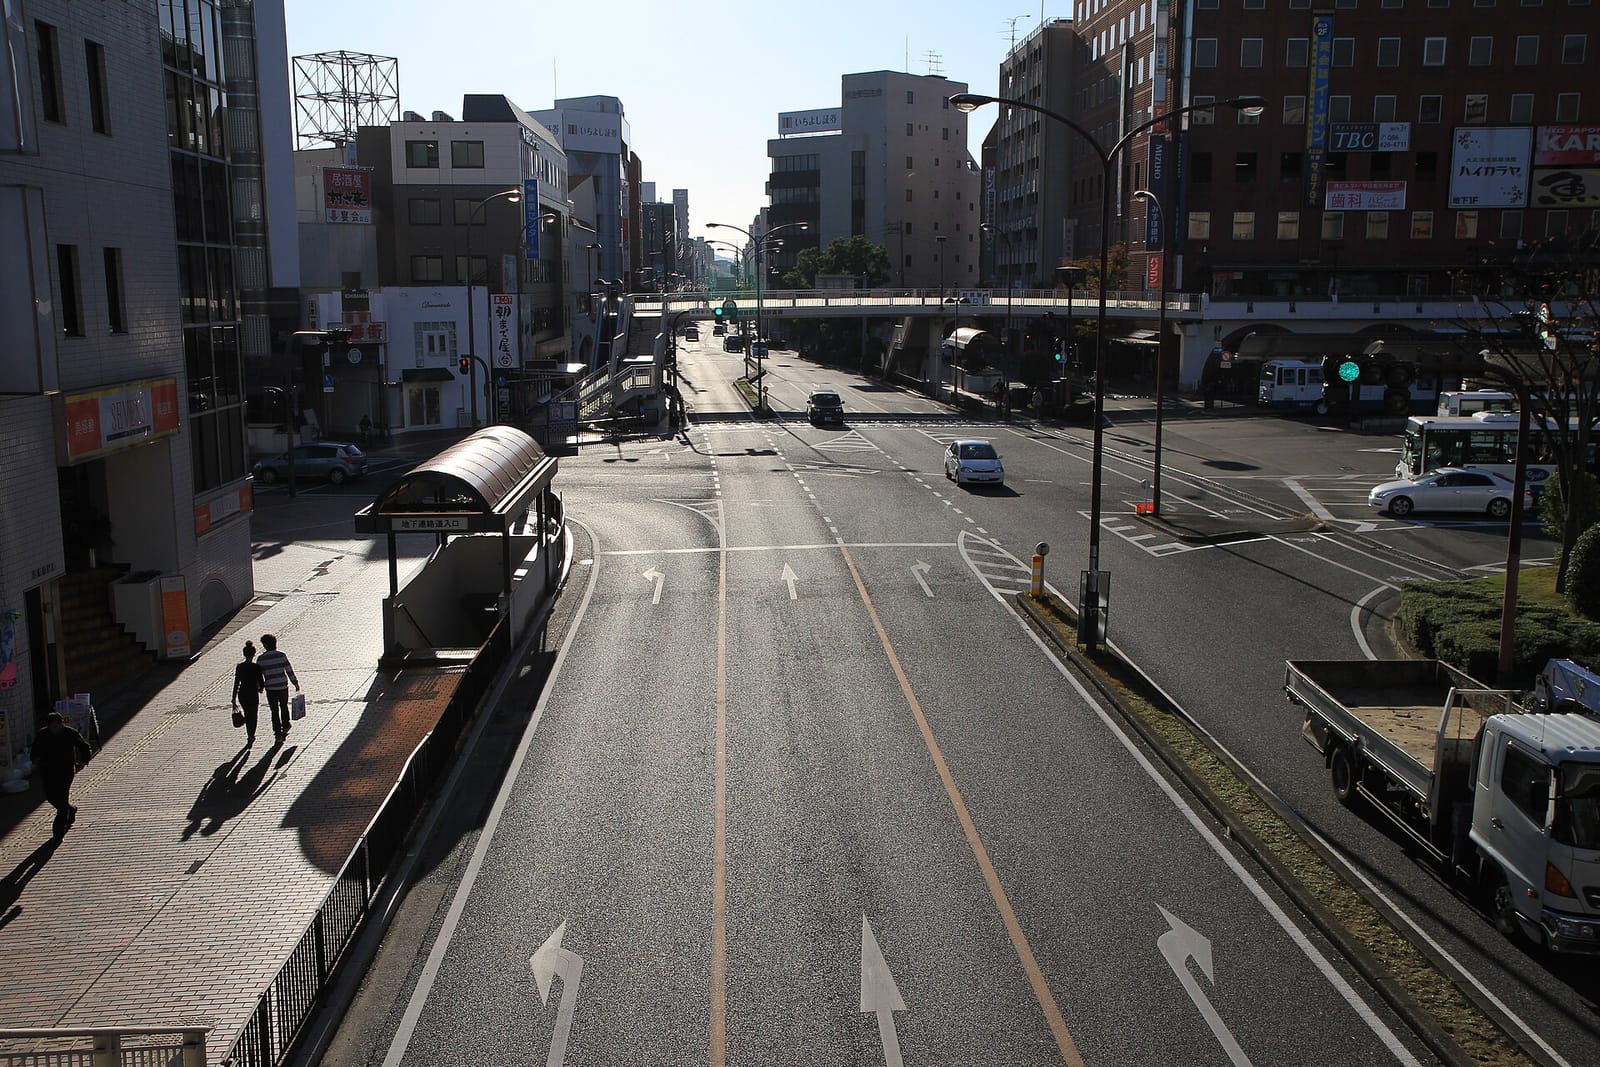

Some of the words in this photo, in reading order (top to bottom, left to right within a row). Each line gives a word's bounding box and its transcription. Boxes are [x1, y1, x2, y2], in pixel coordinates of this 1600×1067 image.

[795, 114, 837, 127] いちよし証券
[580, 127, 617, 138] いちよし証券
[1335, 132, 1374, 149] TBC
[1154, 143, 1163, 180] MIZUHO
[1459, 166, 1521, 177] ハイカラヤ
[333, 173, 362, 188] 居酒屋
[401, 519, 459, 529] 地下連絡道入口
